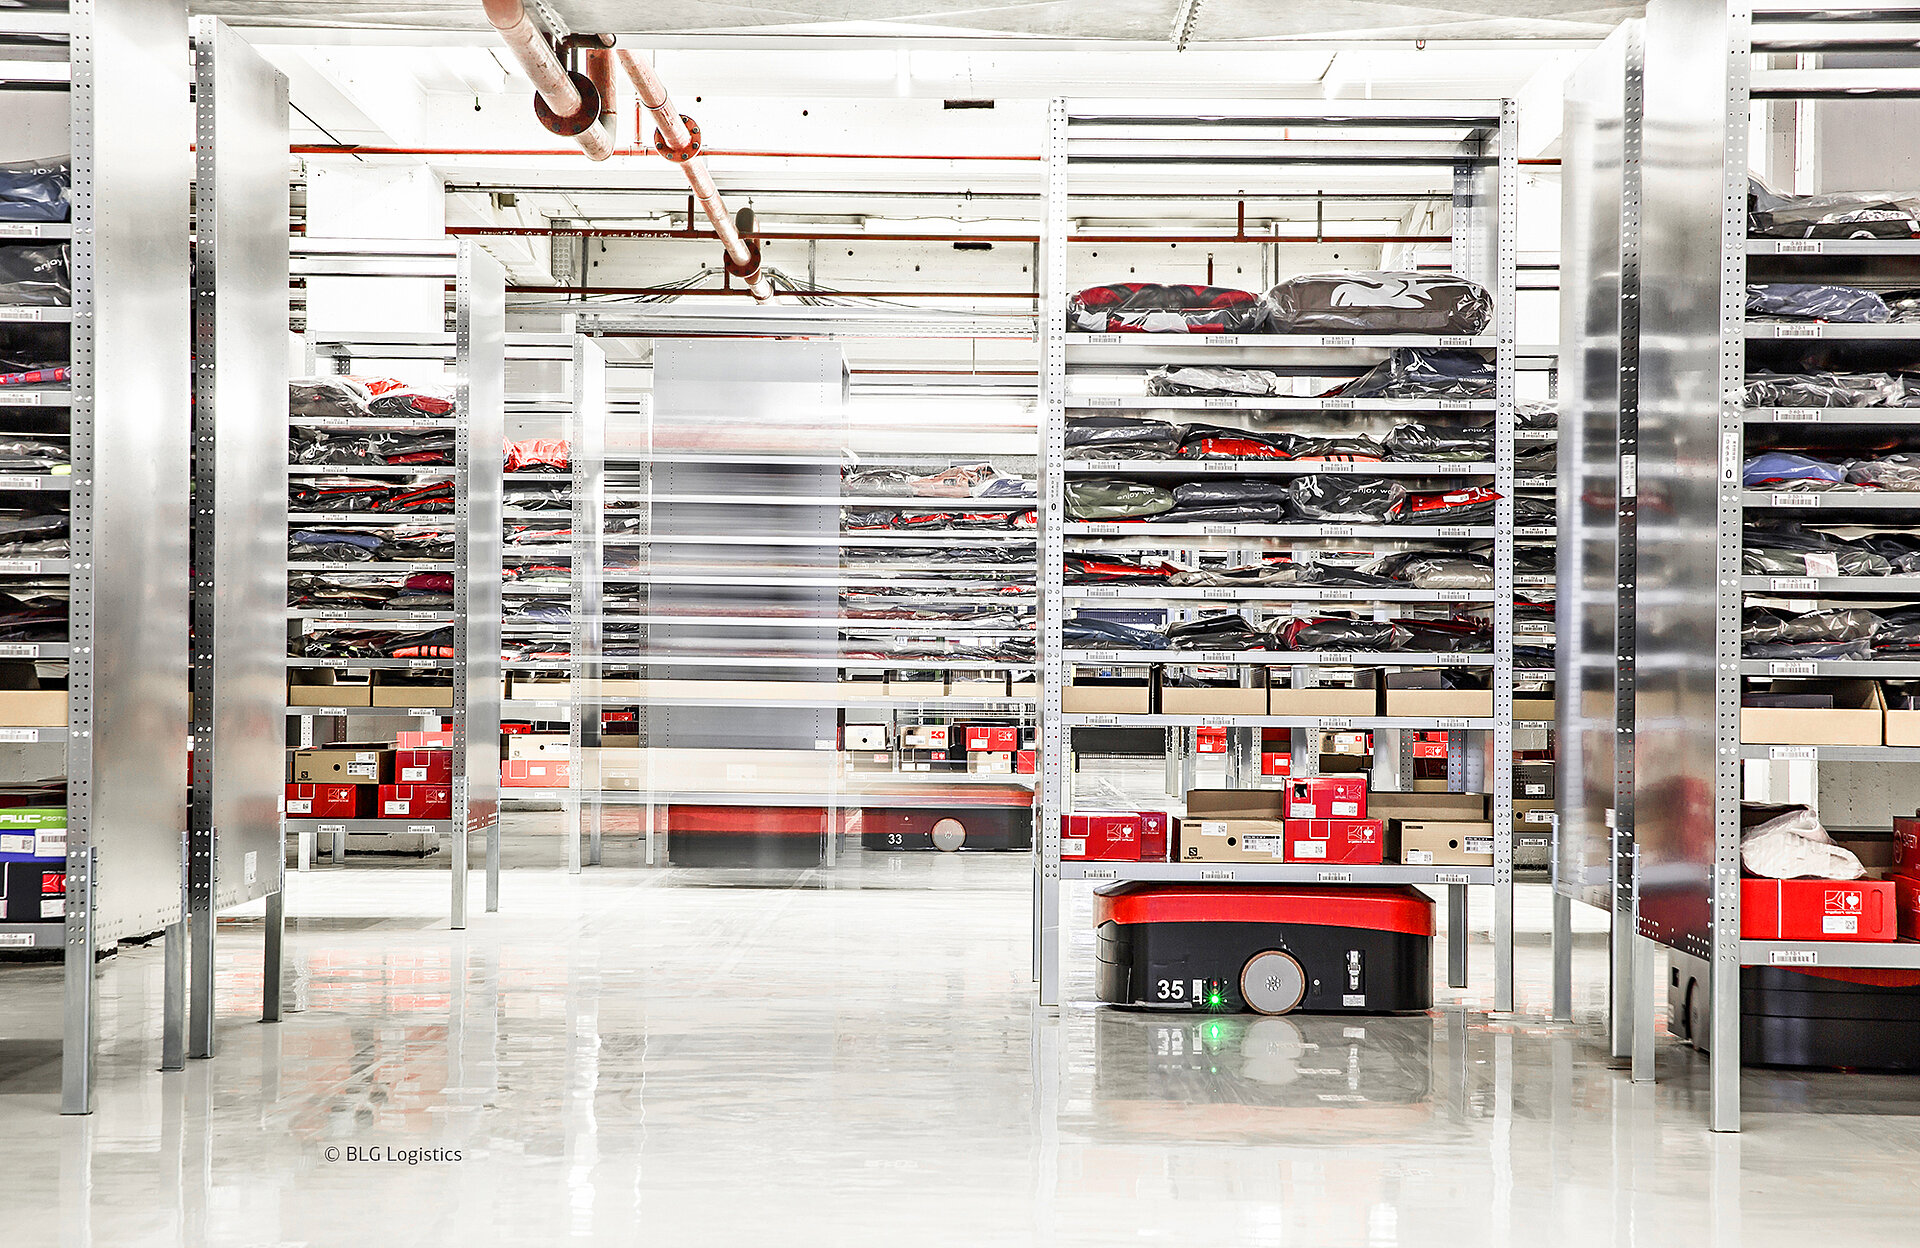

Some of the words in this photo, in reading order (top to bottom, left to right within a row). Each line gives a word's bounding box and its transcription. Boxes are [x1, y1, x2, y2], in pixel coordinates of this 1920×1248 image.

[33, 258, 63, 273] enjoy
[887, 833, 903, 845] 33
[1157, 979, 1184, 1000] 35
